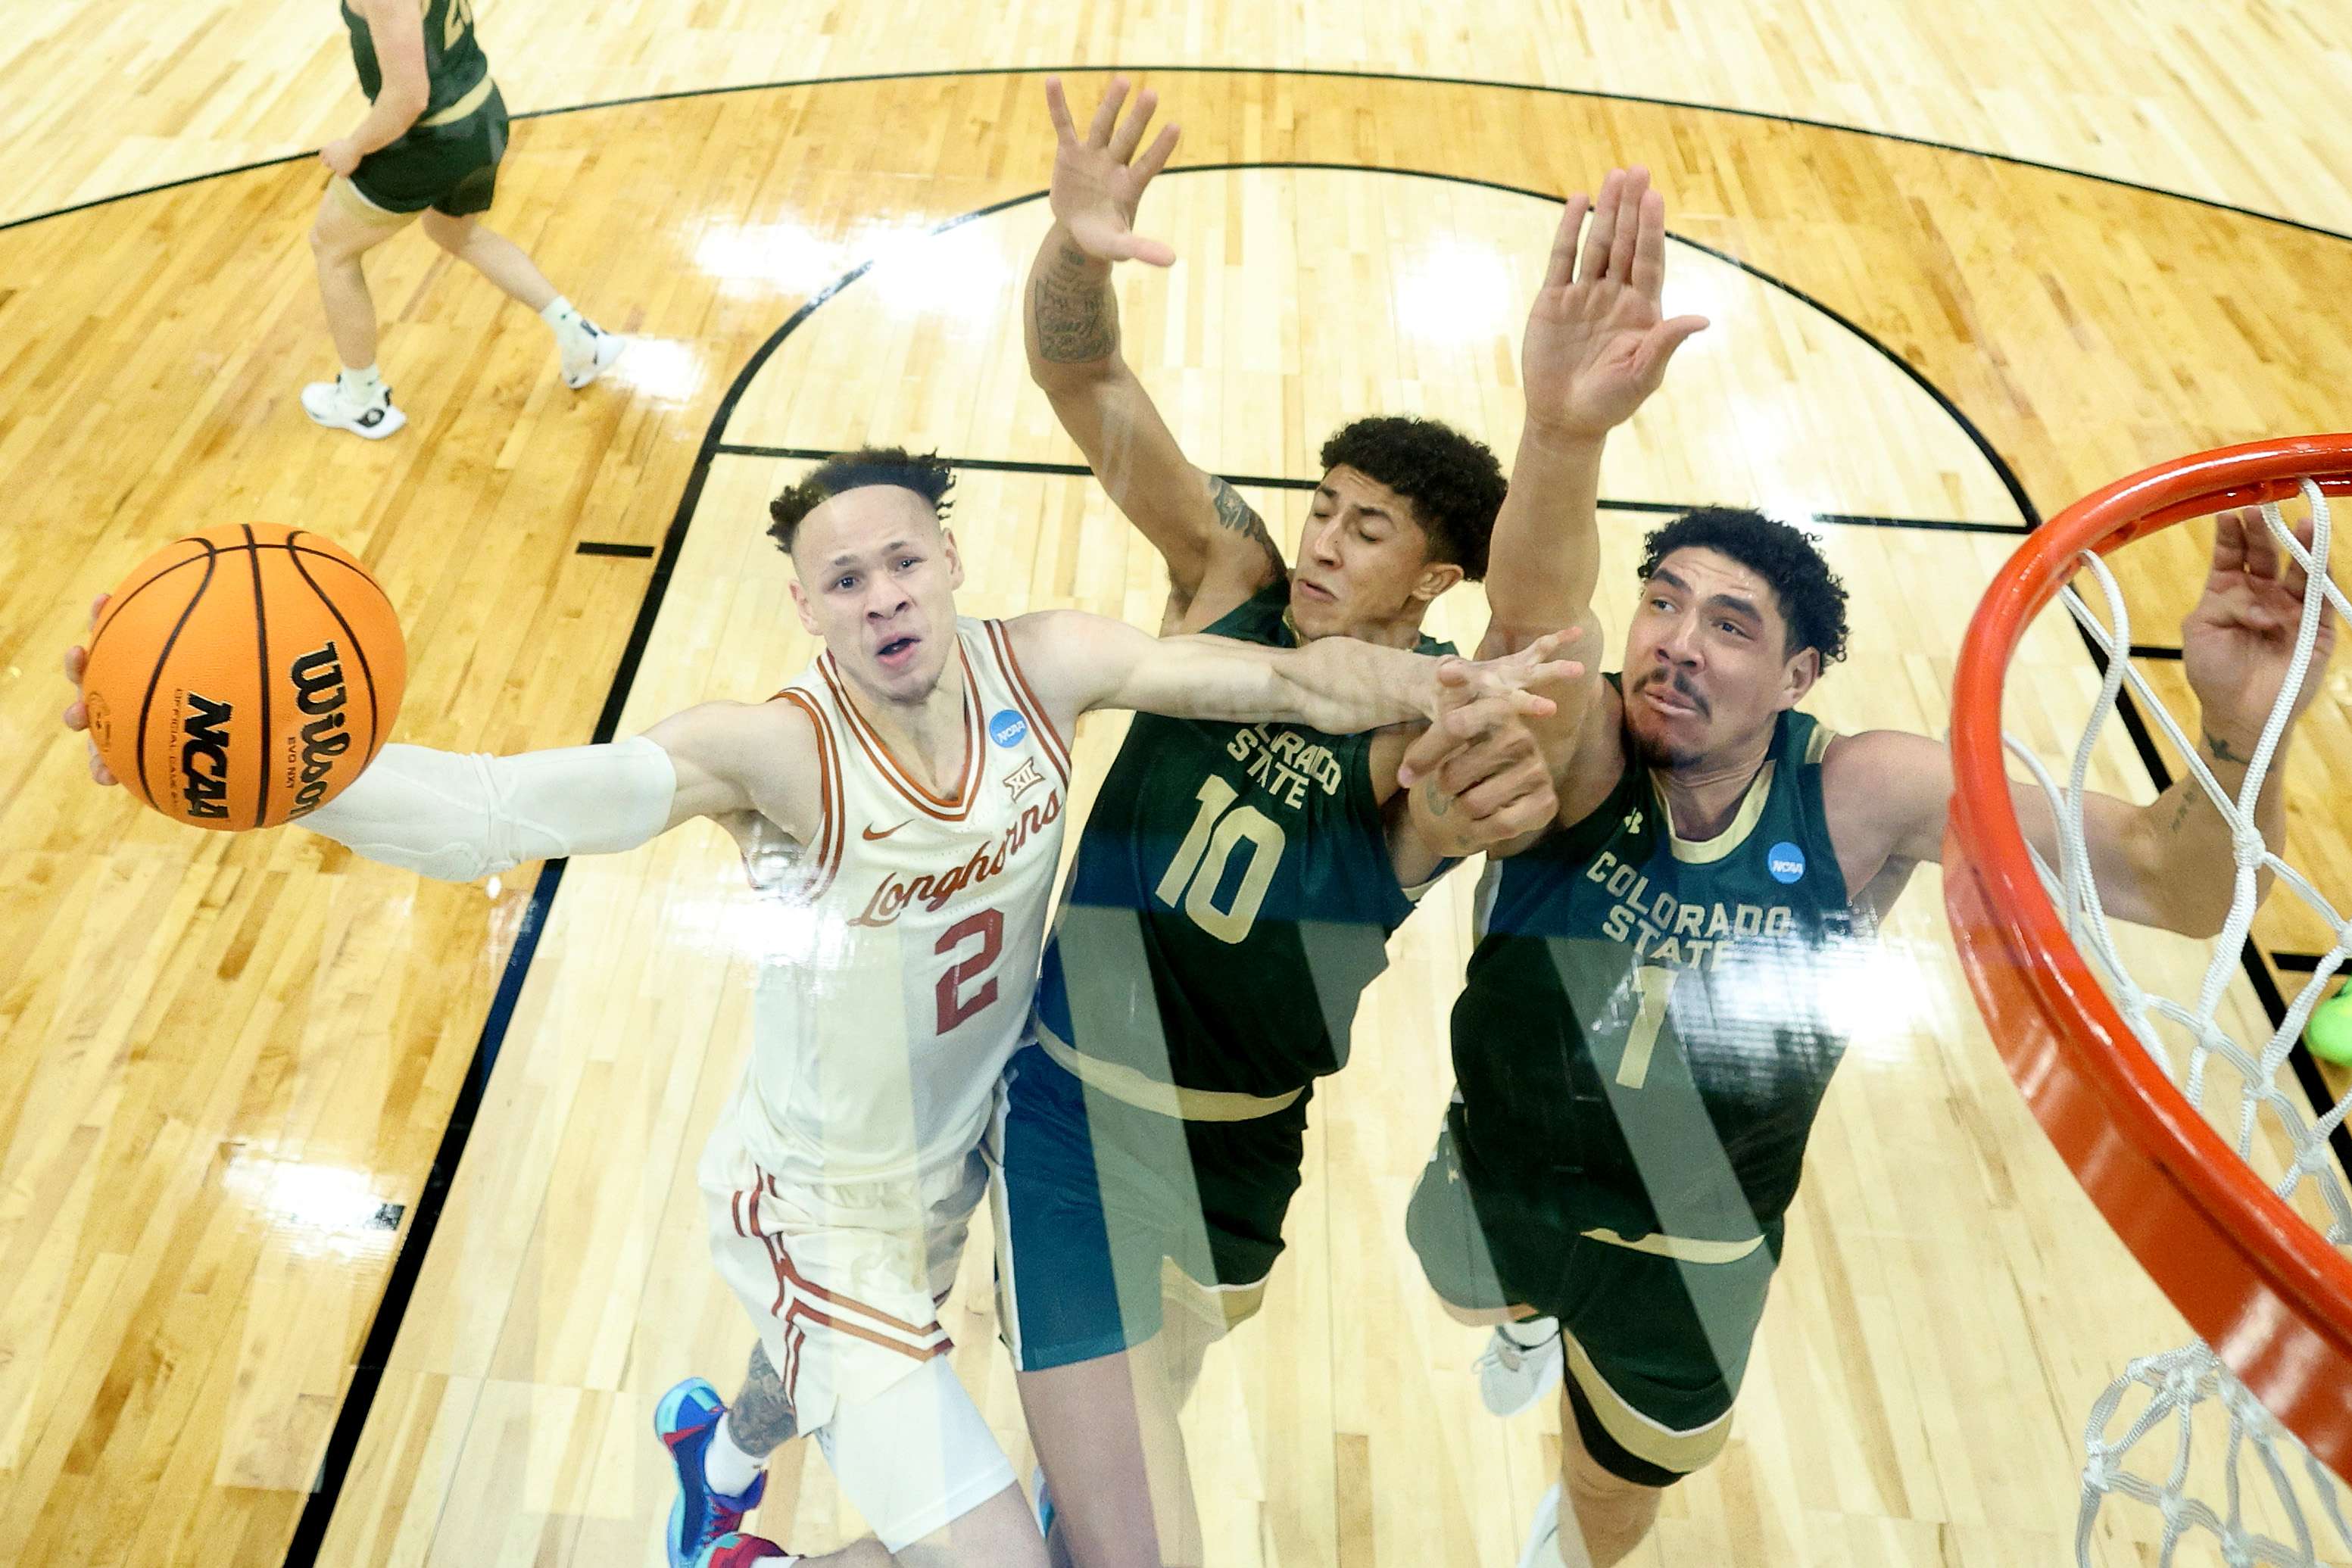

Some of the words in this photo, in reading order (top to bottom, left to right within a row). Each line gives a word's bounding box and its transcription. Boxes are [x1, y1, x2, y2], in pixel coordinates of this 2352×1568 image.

[182, 690, 234, 820] NCAA
[285, 640, 352, 821] Wilson
[288, 737, 298, 763] EVO
[997, 720, 1026, 743] NCAA
[846, 787, 1063, 927] Longhorns
[1156, 773, 1286, 945] 10
[1586, 850, 1792, 938] COLORADO
[1773, 859, 1803, 877] NCAA
[934, 907, 1005, 1036] 2
[1615, 965, 1680, 1089] 1
